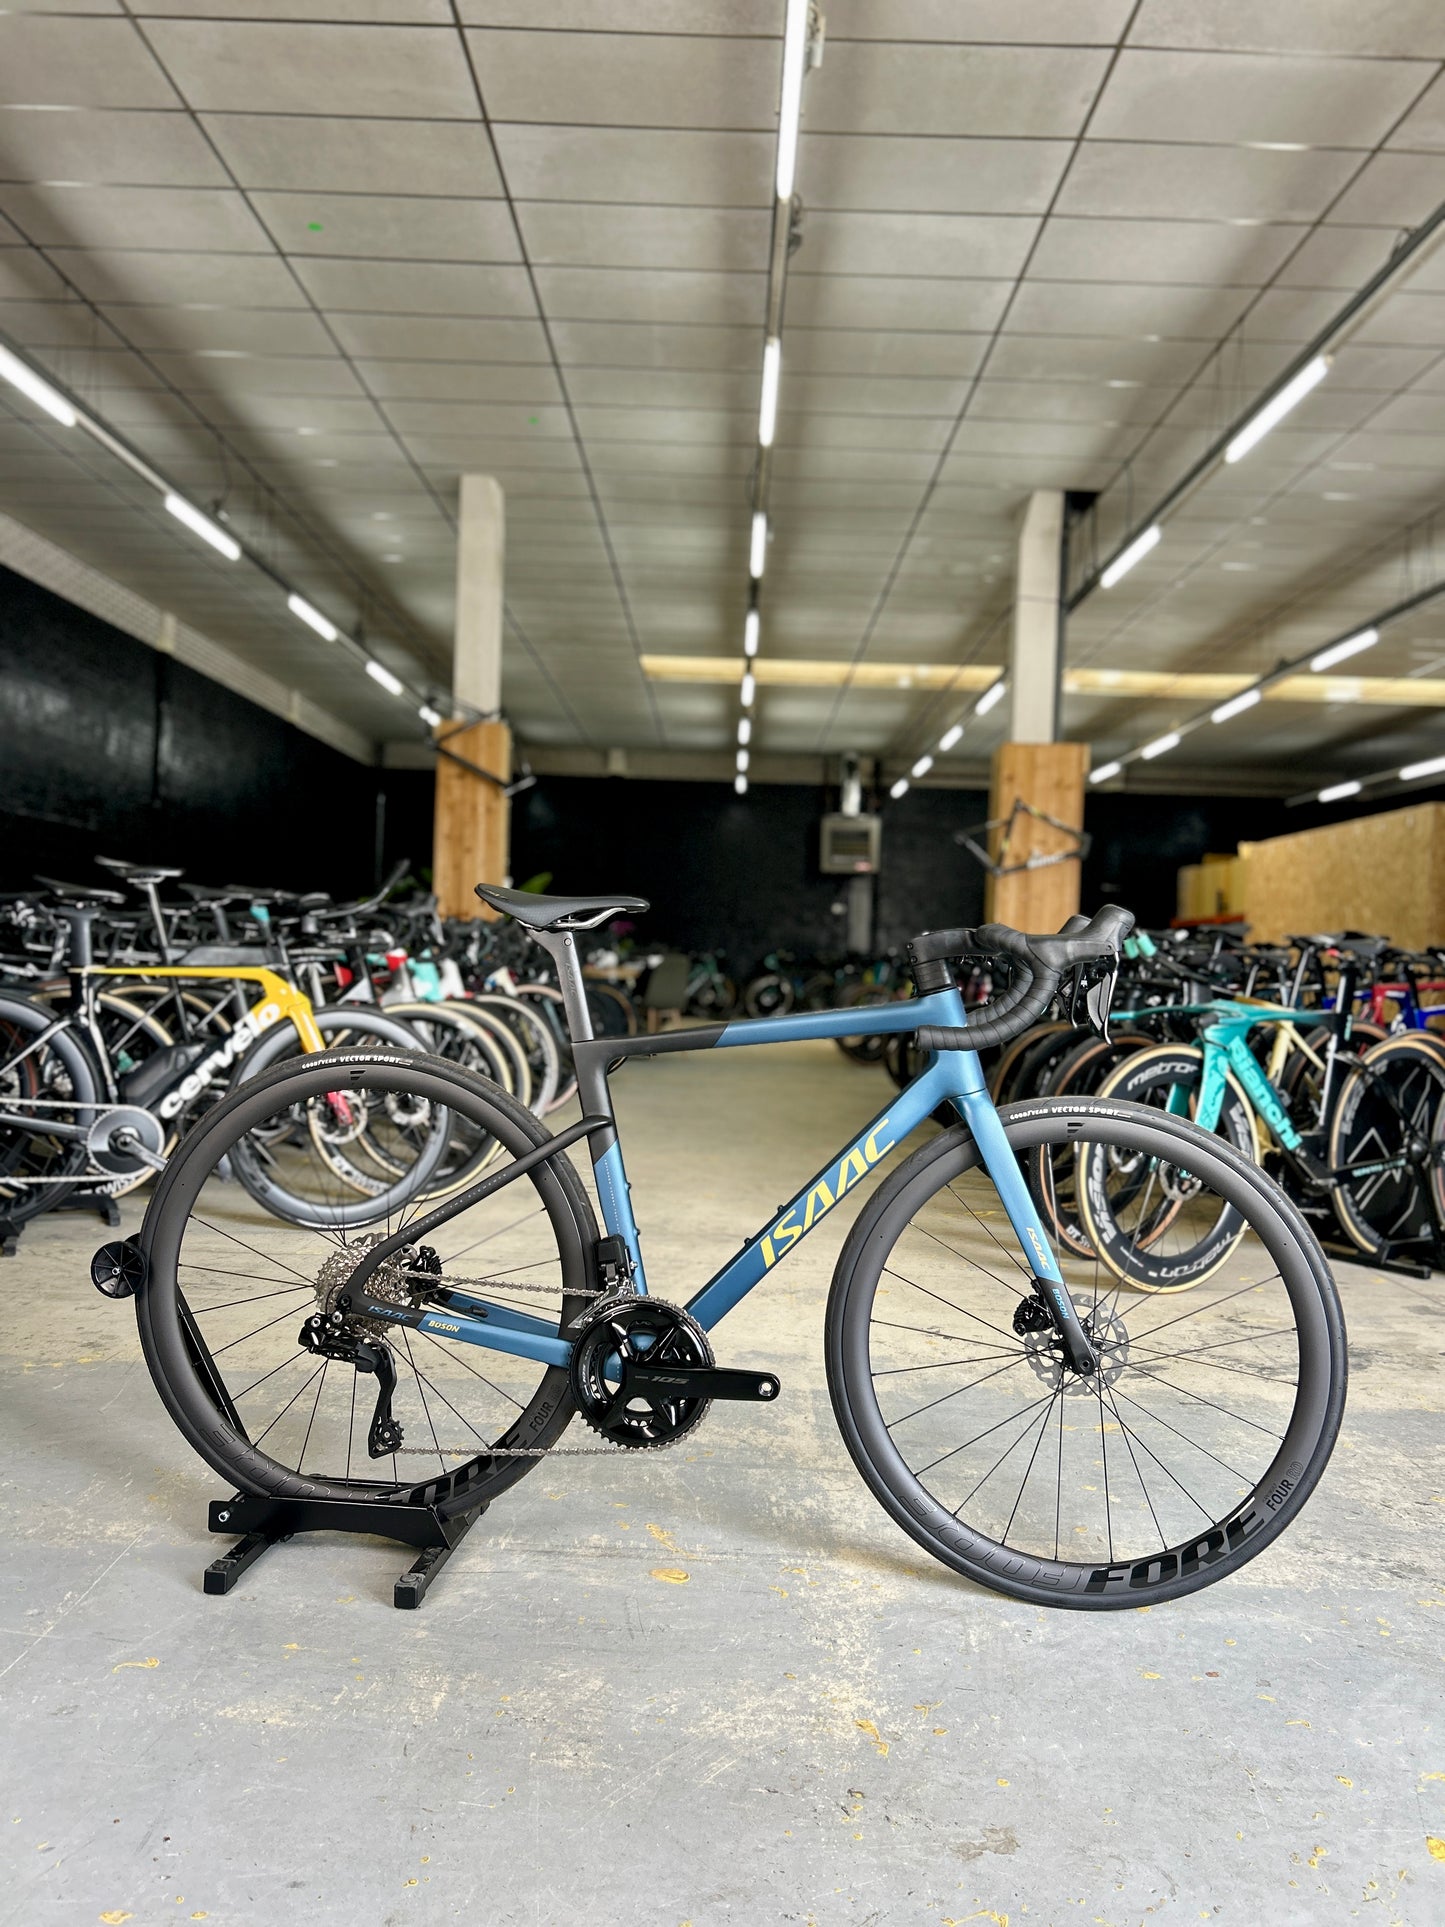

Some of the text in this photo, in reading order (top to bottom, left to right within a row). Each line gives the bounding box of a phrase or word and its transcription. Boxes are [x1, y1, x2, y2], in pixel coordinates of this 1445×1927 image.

[339, 1054, 371, 1064] VECTOR
[372, 1054, 400, 1065] SPORT
[1227, 1036, 1303, 1151] Bianchi
[1009, 1105, 1119, 1121] GOODYEAR VECTOR SPORT
[760, 1118, 896, 1269] ISAAC
[1065, 1224, 1081, 1240] DT
[1025, 1226, 1052, 1272] ISAAC
[367, 1305, 461, 1333] ISAAC BOSON
[1052, 1287, 1070, 1320] BOSON
[651, 1375, 690, 1385] 105
[529, 1401, 554, 1432] FOUR
[1083, 1496, 1265, 1593] FORE
[1265, 1479, 1294, 1511] FOUR
